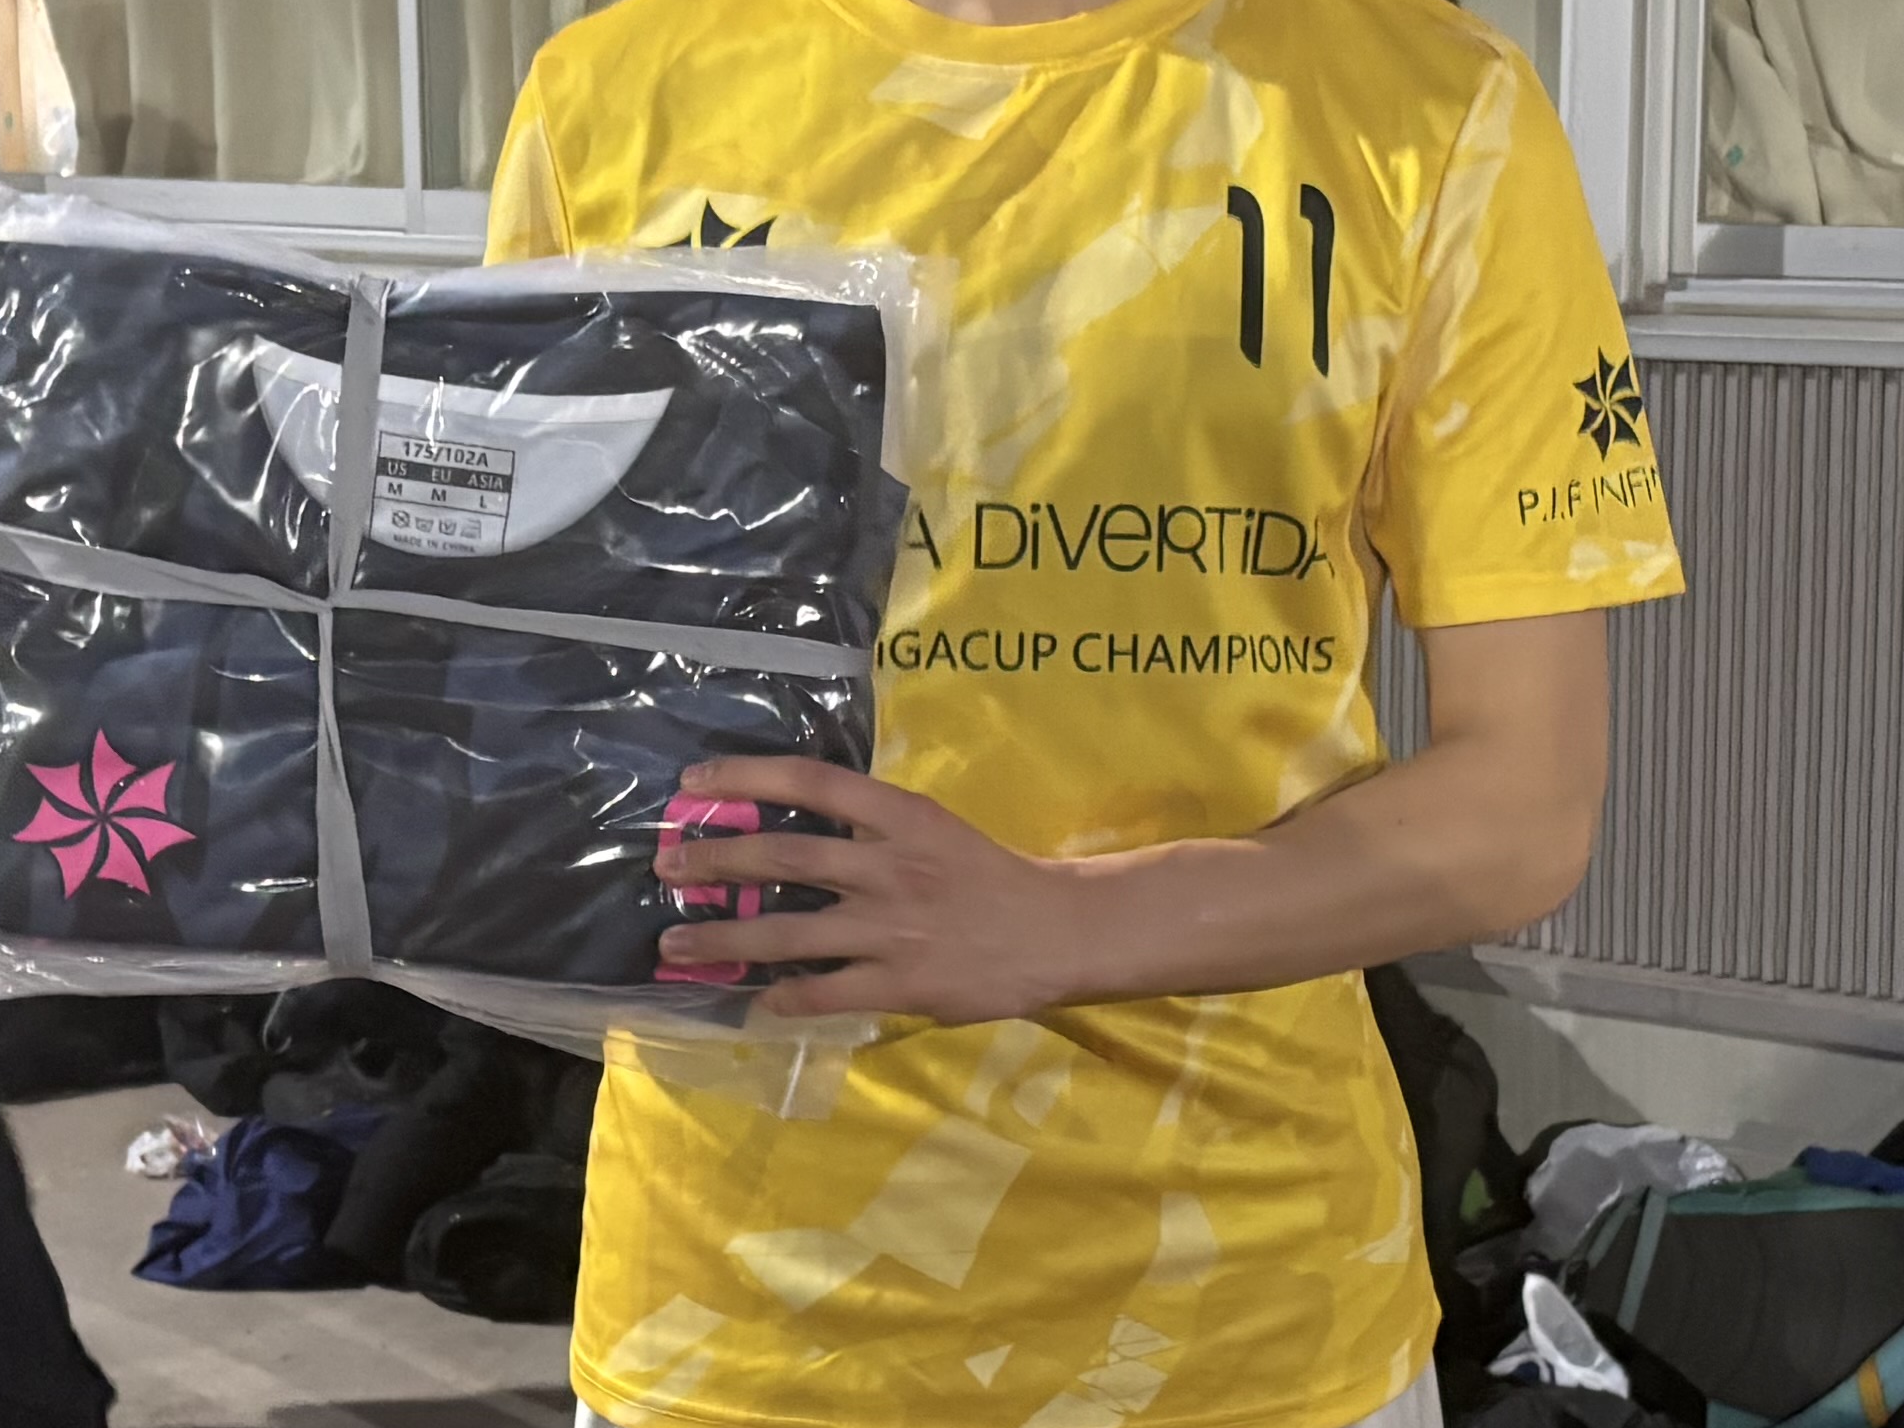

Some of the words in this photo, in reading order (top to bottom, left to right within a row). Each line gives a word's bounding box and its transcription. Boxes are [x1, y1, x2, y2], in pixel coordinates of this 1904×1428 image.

[1227, 183, 1335, 378] 11
[403, 441, 489, 468] 175/102A
[387, 461, 408, 476] US
[431, 468, 452, 482] EU
[467, 474, 504, 490] ASIA
[388, 482, 403, 496] M
[431, 488, 447, 502] M
[479, 495, 488, 509] L
[1072, 632, 1336, 674] CHAMPIONS
